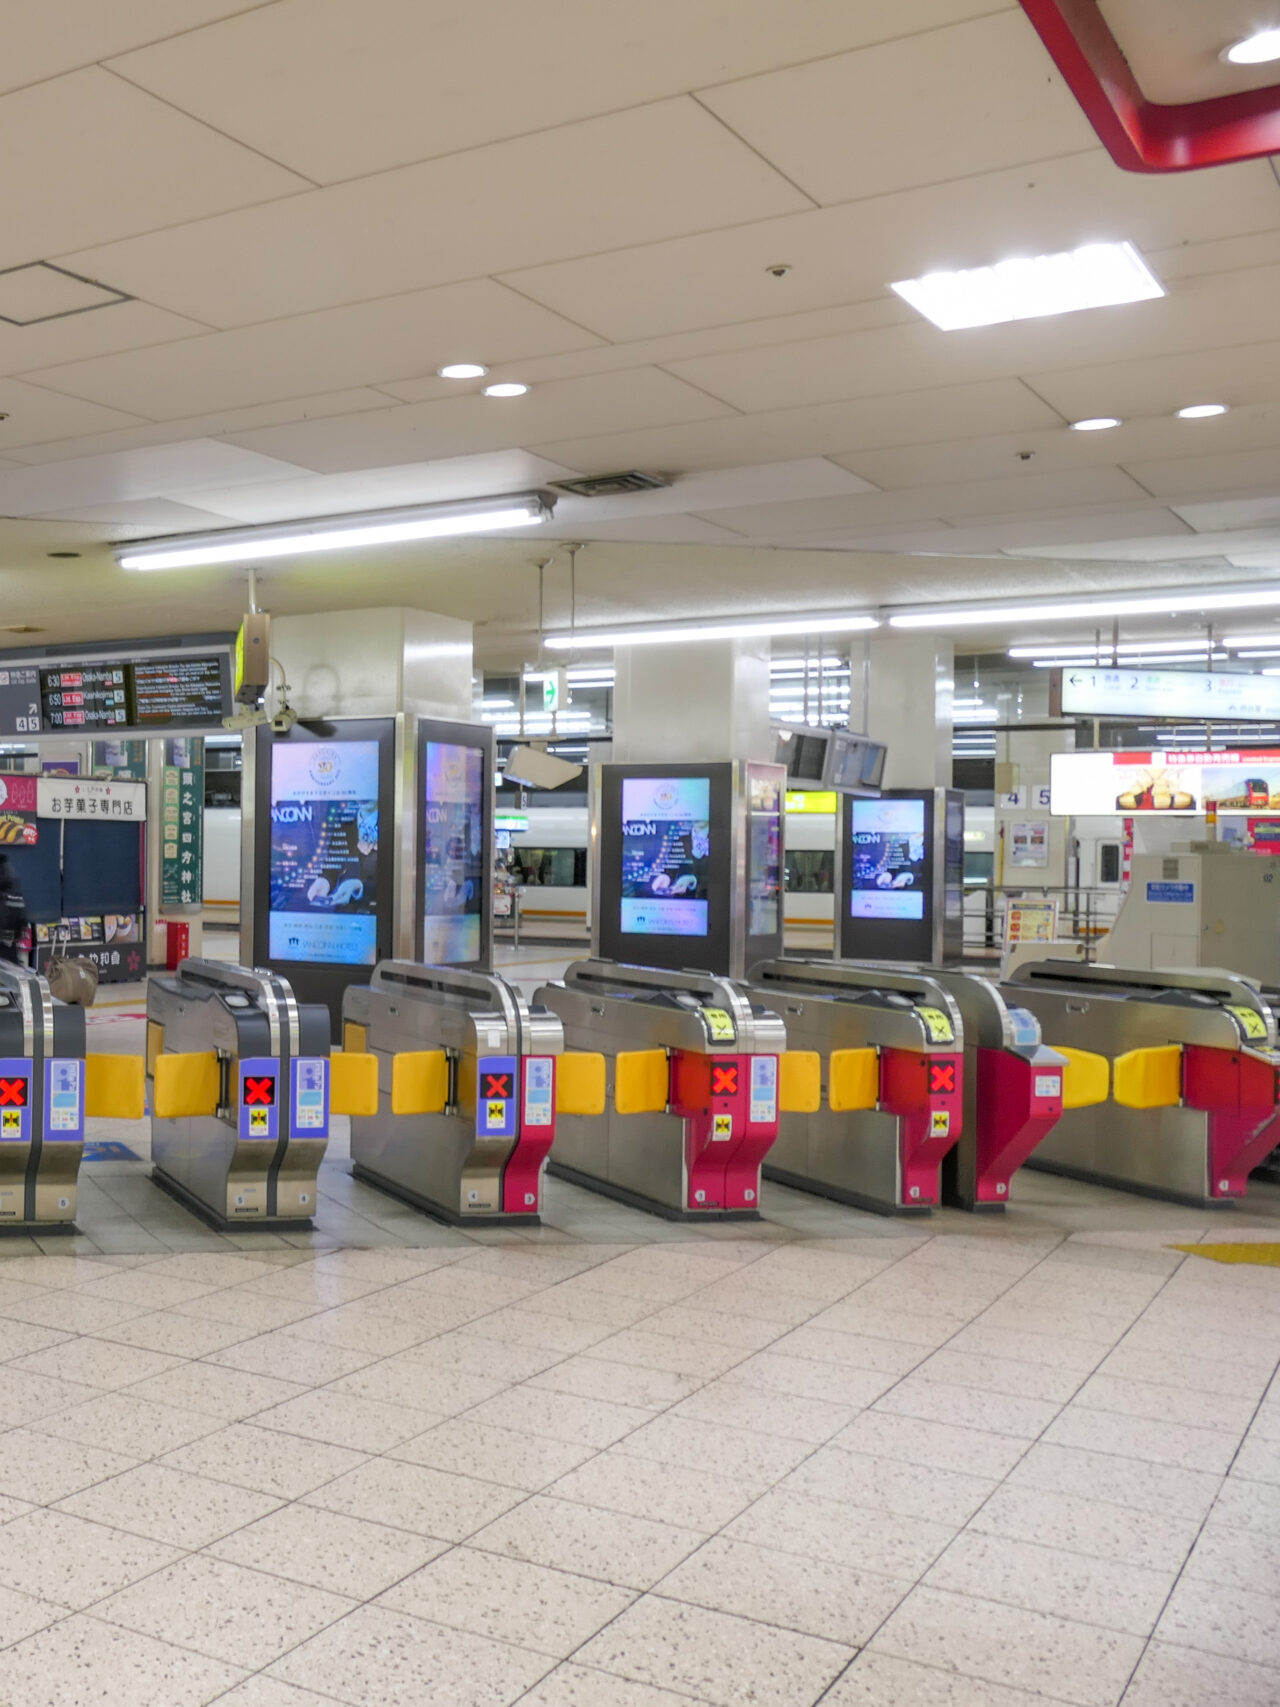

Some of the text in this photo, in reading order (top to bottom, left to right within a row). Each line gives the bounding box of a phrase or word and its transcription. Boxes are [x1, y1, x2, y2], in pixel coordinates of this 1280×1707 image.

[1090, 676, 1096, 687] 1
[1130, 676, 1139, 689] 2
[1205, 679, 1212, 693] 3
[1008, 790, 1051, 805] 4 5
[52, 797, 133, 815] お芋菓子専門店
[1263, 874, 1273, 883] 02
